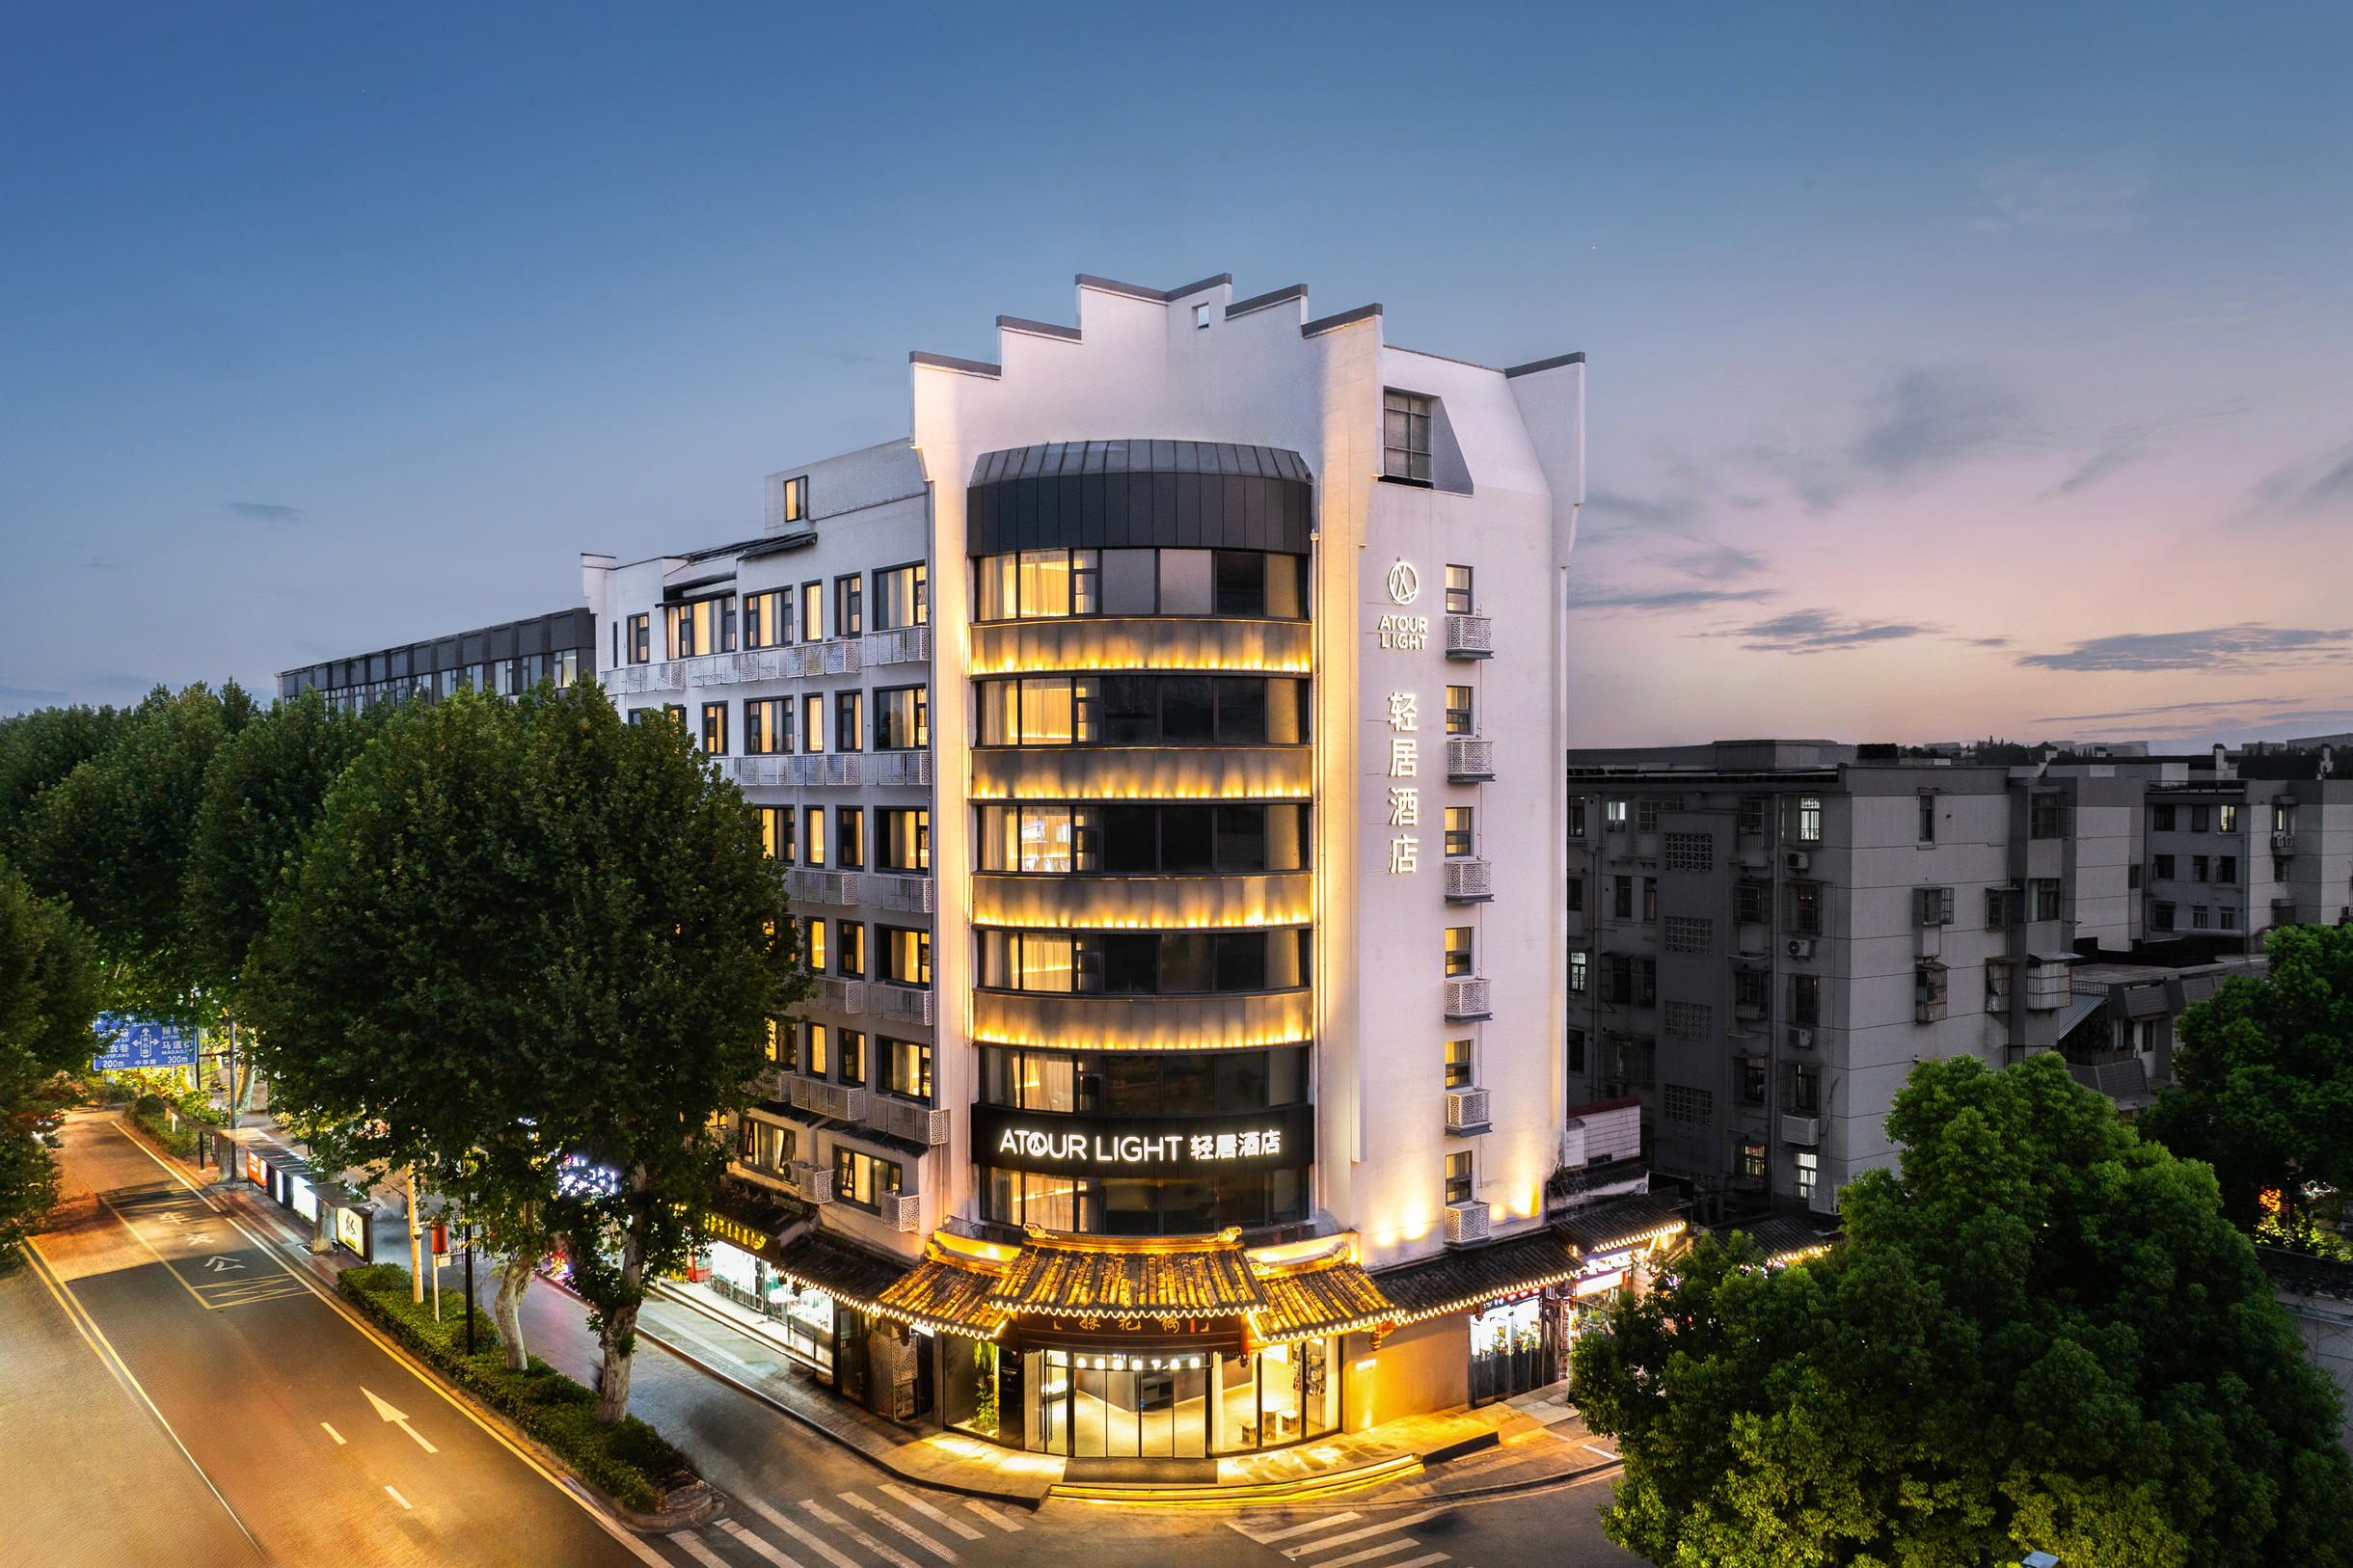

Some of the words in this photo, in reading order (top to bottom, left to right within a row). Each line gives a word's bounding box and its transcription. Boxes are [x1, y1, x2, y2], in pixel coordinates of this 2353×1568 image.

[1379, 614, 1428, 633] ATOUR
[1379, 633, 1428, 650] LIGHT
[1388, 691, 1420, 875] 轻居酒店
[102, 1059, 124, 1068] 200m
[167, 1055, 188, 1064] 300m
[998, 1127, 1089, 1161] ATOUR
[1095, 1135, 1184, 1163] LIGHT
[1189, 1129, 1282, 1161] 轻居酒店
